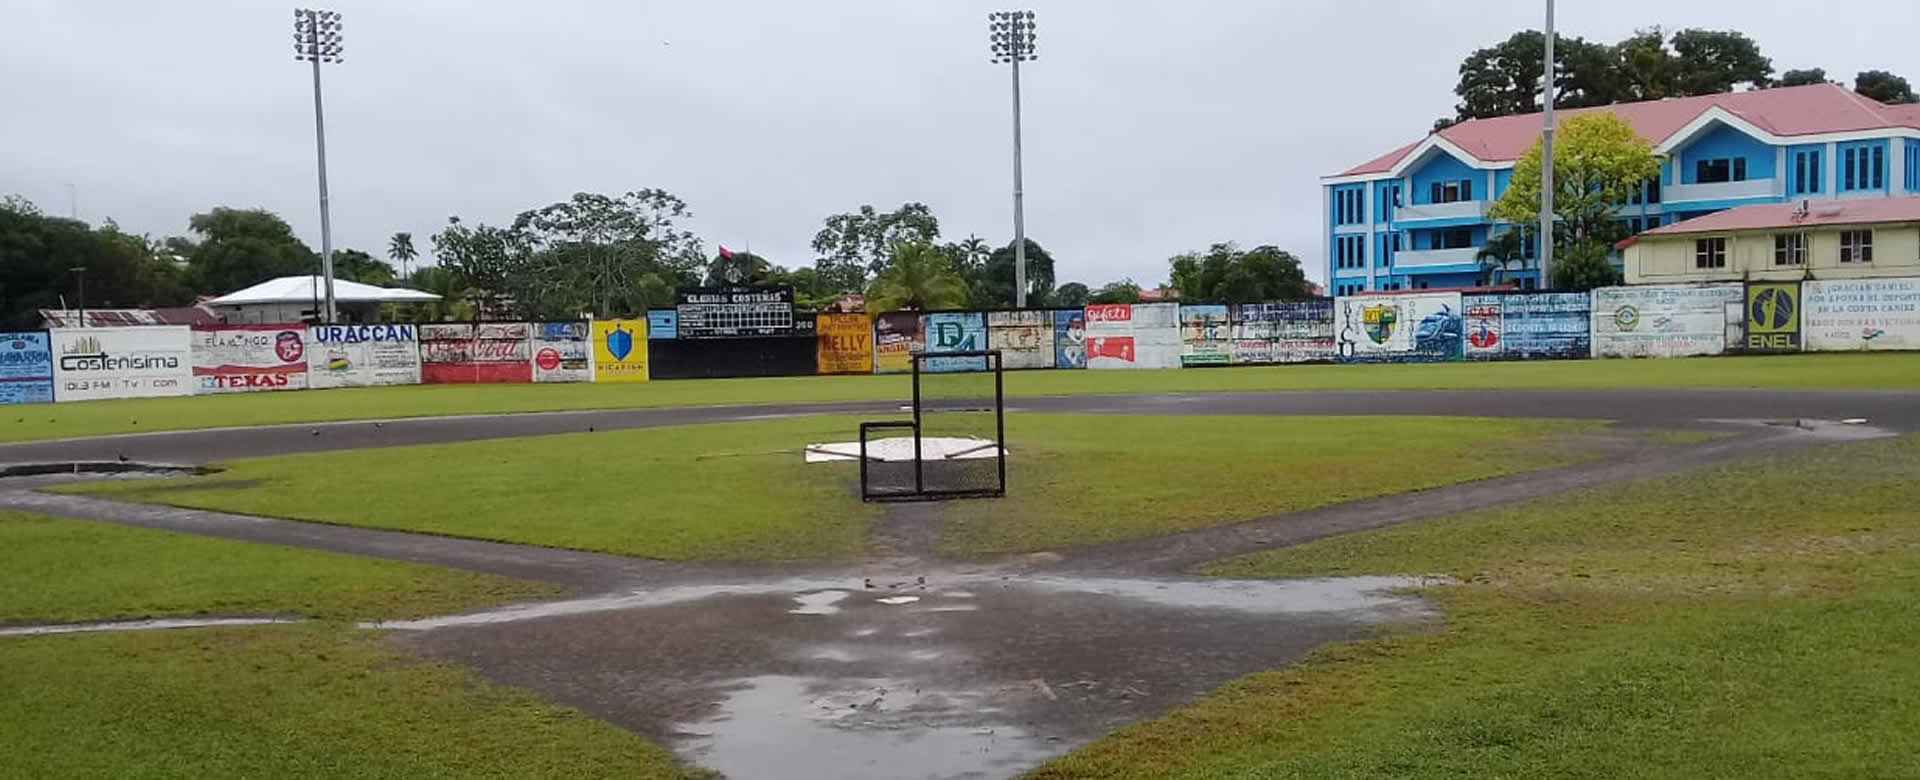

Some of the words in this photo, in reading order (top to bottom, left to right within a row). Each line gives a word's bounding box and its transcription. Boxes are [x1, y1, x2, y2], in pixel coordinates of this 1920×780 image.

[316, 326, 413, 343] URACCAN
[1751, 335, 1795, 348] ENEL
[214, 373, 288, 388] TEXAS
